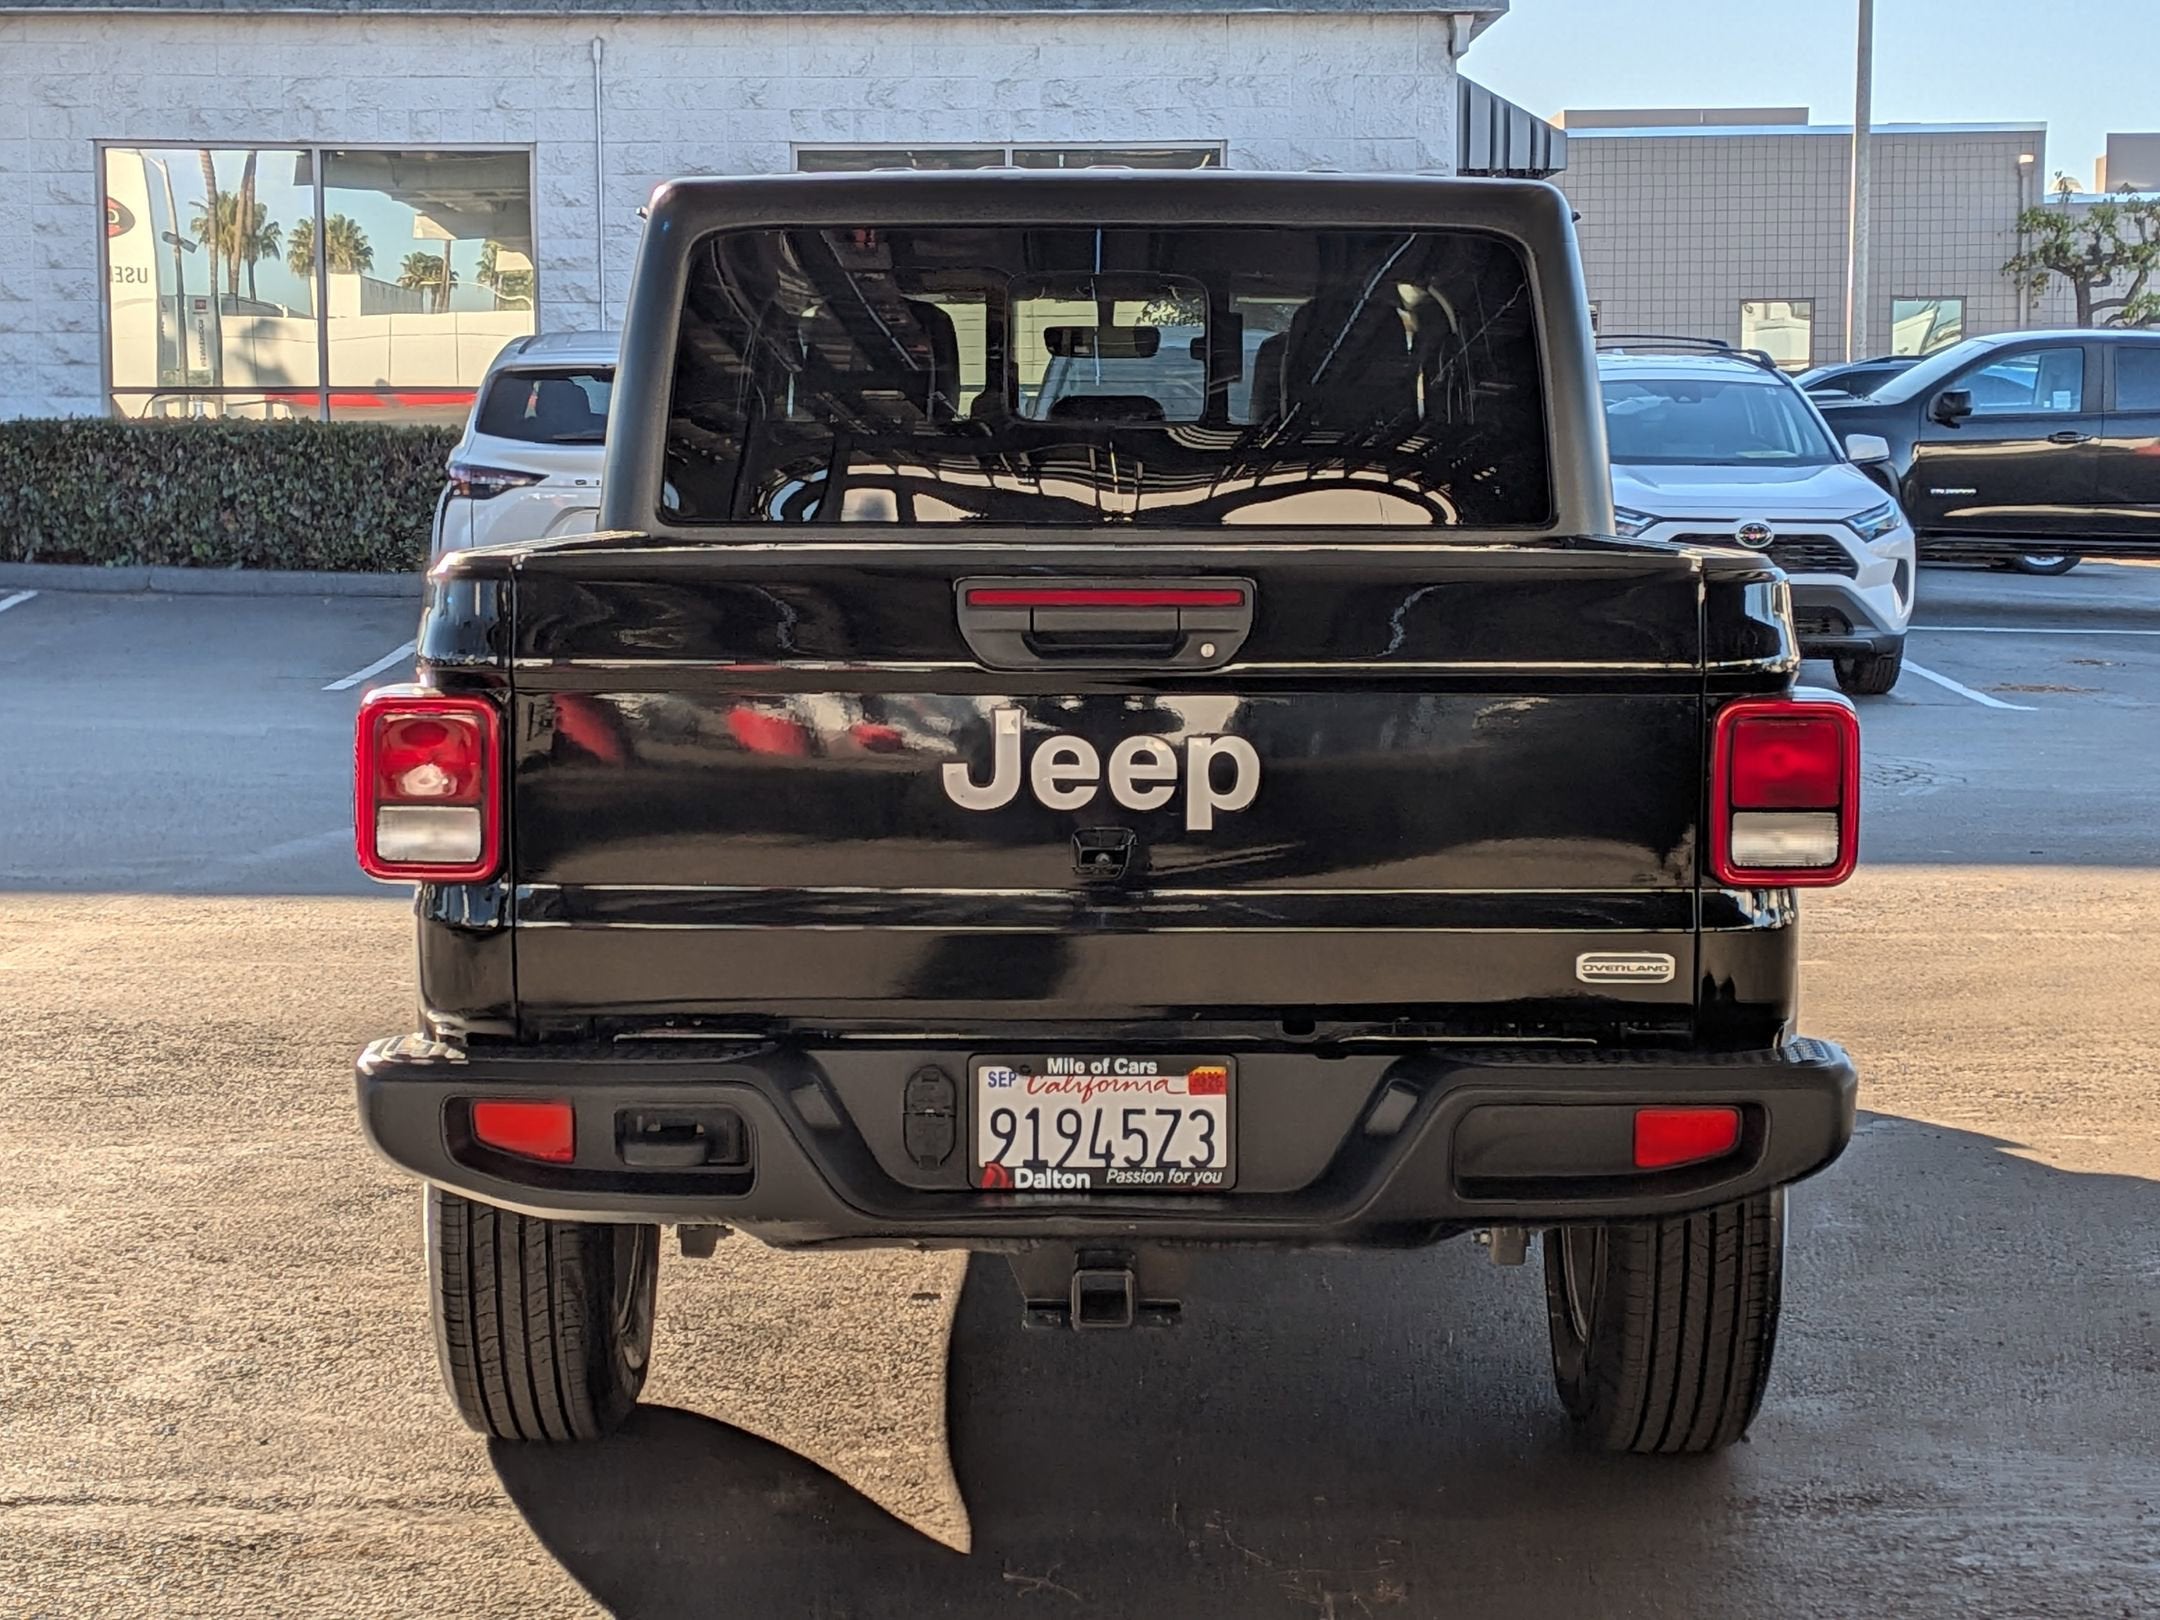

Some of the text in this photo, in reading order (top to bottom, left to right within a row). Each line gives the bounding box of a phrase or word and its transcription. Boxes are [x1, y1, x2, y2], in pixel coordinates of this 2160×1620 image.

[942, 708, 1261, 831] Jeep
[1581, 964, 1670, 972] OVERLAND
[1047, 1057, 1158, 1075] Mile of Cars
[988, 1071, 1017, 1088] SEP
[1026, 1074, 1187, 1104] California
[990, 1107, 1216, 1167] 91945Z3
[1014, 1168, 1091, 1189] Dalton
[1106, 1168, 1223, 1187] Passion for you
